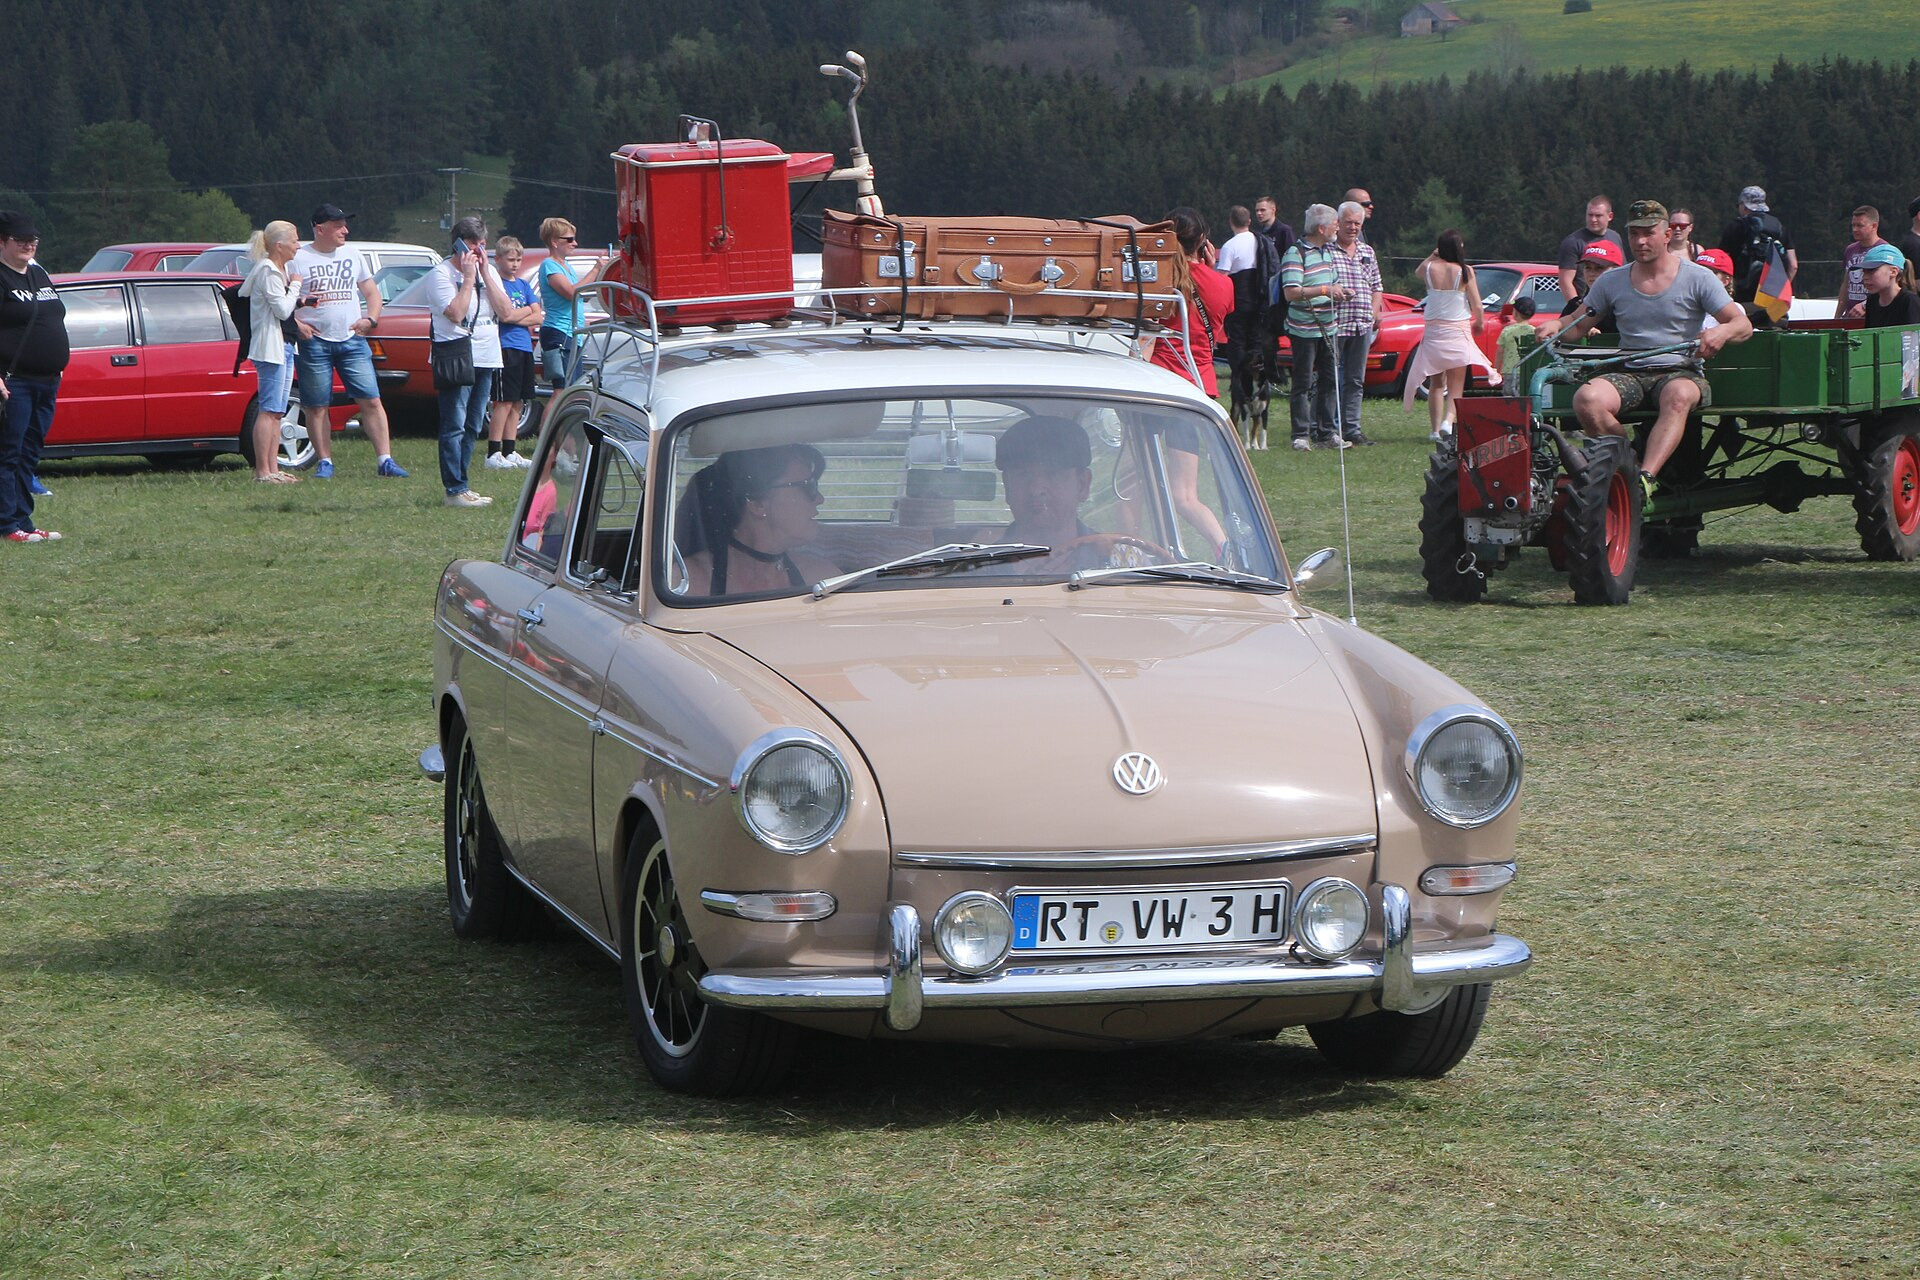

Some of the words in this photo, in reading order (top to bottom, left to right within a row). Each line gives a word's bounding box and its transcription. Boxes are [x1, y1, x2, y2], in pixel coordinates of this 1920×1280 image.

[1585, 247, 1607, 256] MOTUL
[310, 277, 355, 292] DENIM
[1040, 901, 1099, 942] RT
[1132, 898, 1187, 939] VW
[1208, 895, 1234, 936] 3
[1252, 893, 1281, 934] H
[1019, 928, 1030, 940] D
